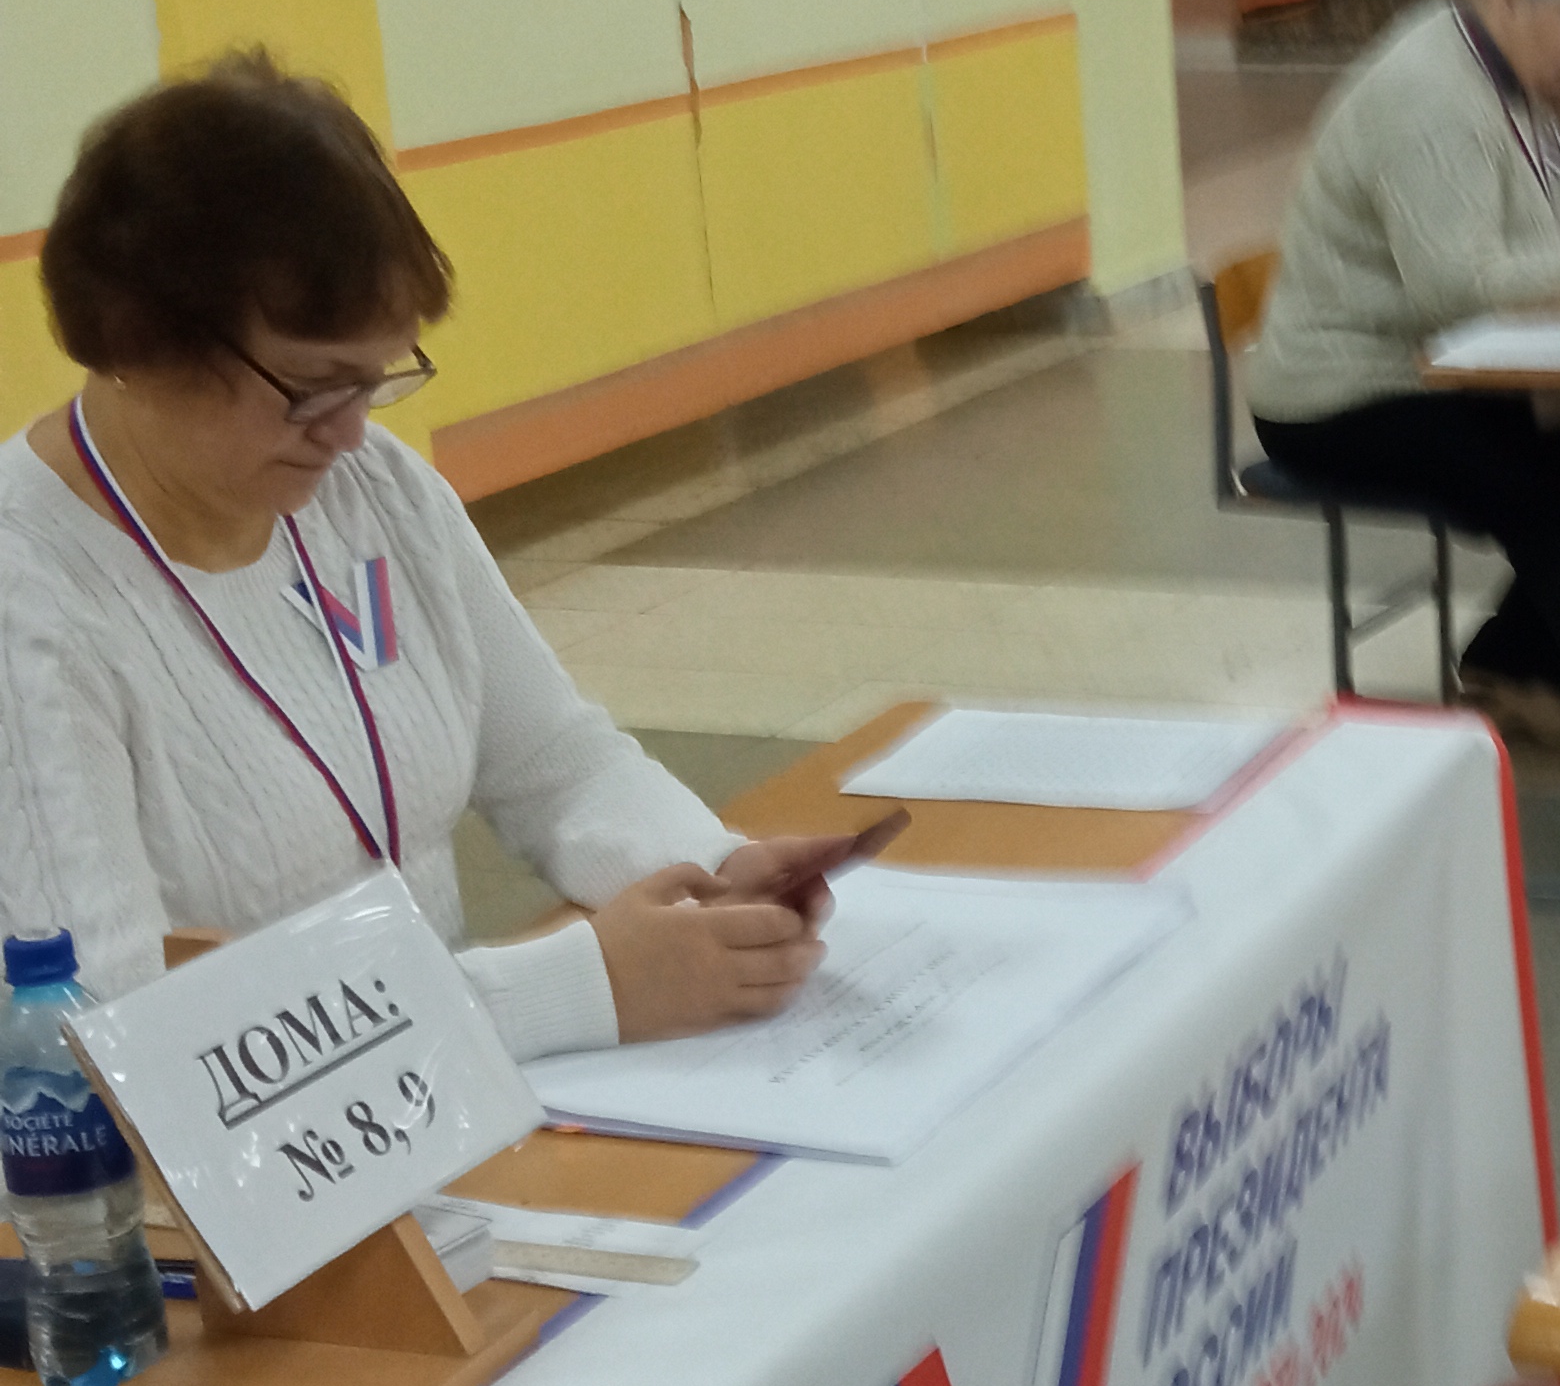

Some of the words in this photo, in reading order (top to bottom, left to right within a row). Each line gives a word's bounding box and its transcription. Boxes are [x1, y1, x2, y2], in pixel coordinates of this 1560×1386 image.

[197, 979, 402, 1127] ДОМА:
[1164, 943, 1347, 1213] ВЫБОРЫ
[1142, 1015, 1392, 1365] ПРЕЗИДЕНТА
